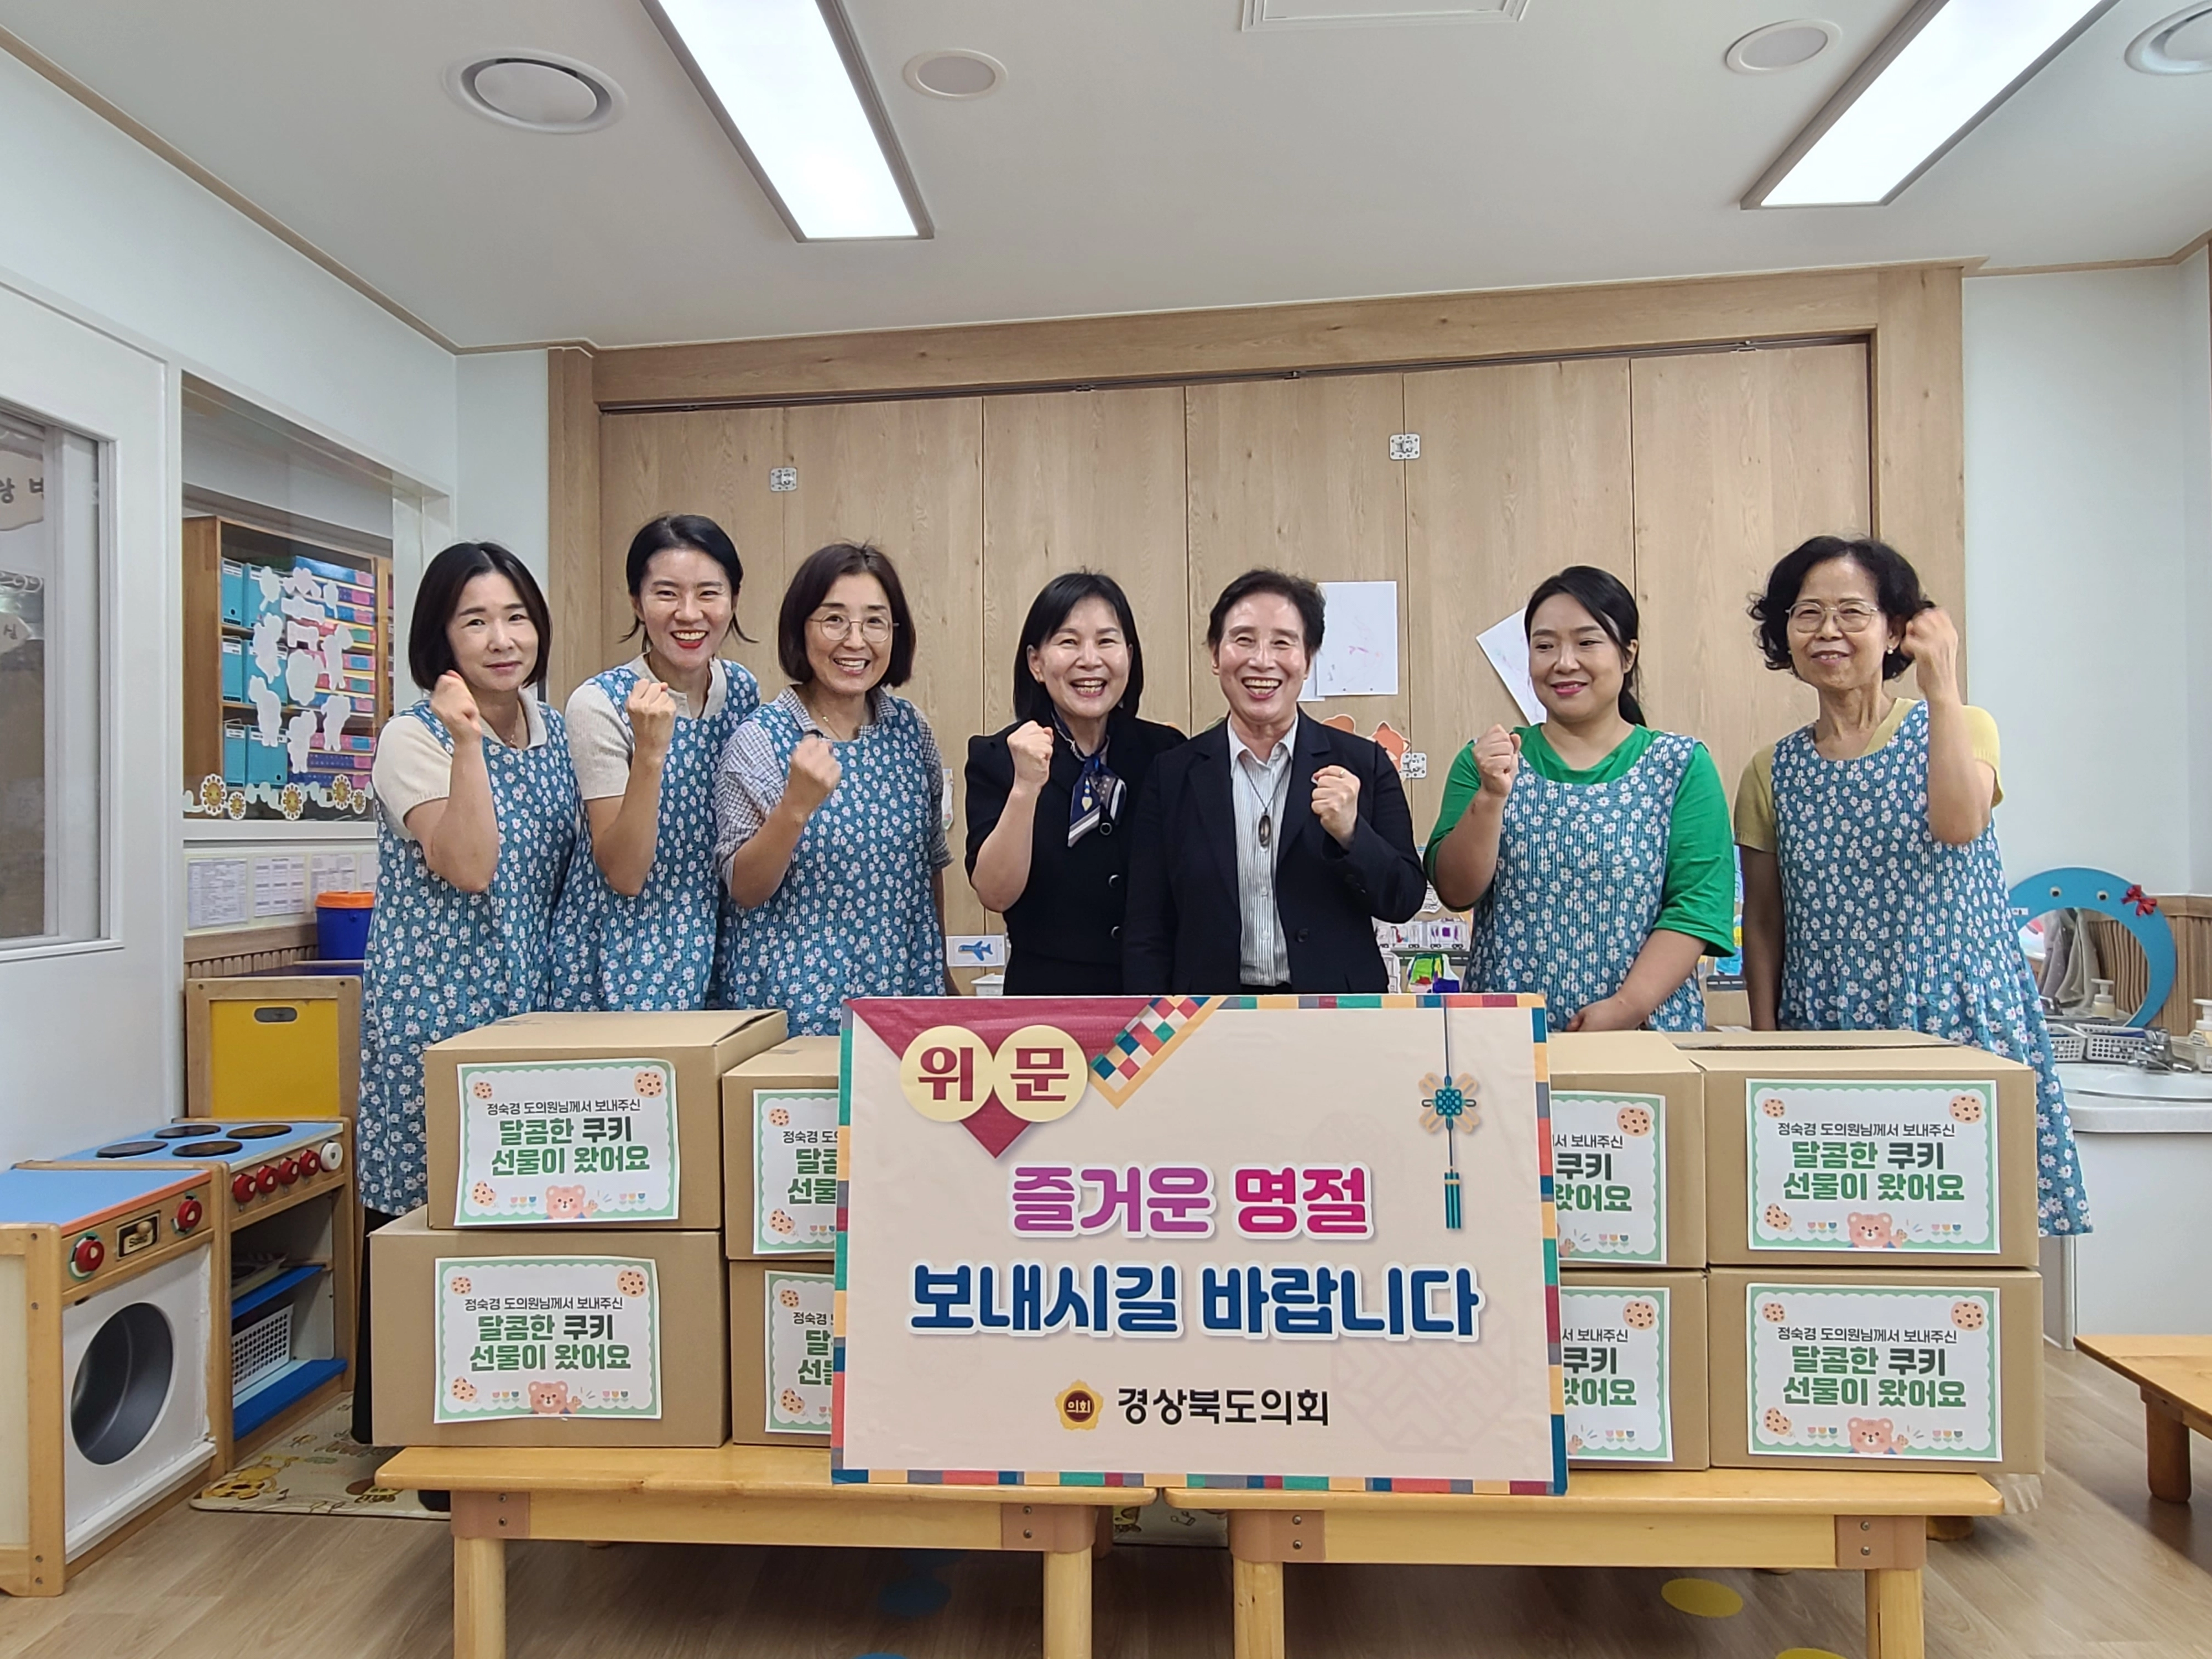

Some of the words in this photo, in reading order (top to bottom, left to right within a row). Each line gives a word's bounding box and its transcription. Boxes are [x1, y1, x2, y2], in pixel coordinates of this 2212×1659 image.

[917, 1047, 1070, 1102] 위문
[487, 1102, 520, 1116] 정숙경
[524, 1100, 592, 1114] 도의원님께서
[595, 1099, 641, 1112] 보내주신
[499, 1118, 574, 1146] 달콤한
[582, 1116, 632, 1143] 쿠키
[782, 1130, 818, 1144] 정숙경
[1571, 1135, 1623, 1149] 보내주신
[1777, 1122, 1817, 1136] 정숙경
[1820, 1123, 1898, 1137] 도의원님께서
[1902, 1124, 1955, 1138] 보내주신
[492, 1147, 565, 1176] 선물이
[574, 1146, 650, 1173] 왔어요
[1556, 1153, 1612, 1181] 쿠키
[1792, 1141, 1878, 1170] 달콤한
[1887, 1142, 1944, 1170] 쿠키
[1012, 1166, 1211, 1233] 즐거운
[1235, 1167, 1368, 1233] 명절
[1783, 1172, 1867, 1201] 선물이
[1877, 1173, 1965, 1202] 왔어요
[465, 1297, 500, 1311] 정숙경
[504, 1297, 574, 1310] 도의원님께서
[577, 1297, 623, 1310] 보내주신
[910, 1264, 1178, 1332] 보내시길
[1202, 1266, 1480, 1336] 바랍니다
[478, 1314, 555, 1341] 달콤한
[563, 1314, 613, 1340] 쿠키
[792, 1312, 827, 1326] 정숙경
[1577, 1328, 1628, 1343] 보내주신
[1777, 1326, 1817, 1341] 정숙경
[1820, 1328, 1900, 1343] 도의원님께서
[1903, 1329, 1958, 1344] 보내주신
[469, 1344, 546, 1372] 선물이
[555, 1344, 632, 1370] 왔어요
[1563, 1347, 1617, 1375] 쿠키
[1792, 1345, 1879, 1375] 달콤한
[1888, 1348, 1946, 1376] 쿠키
[1066, 1400, 1091, 1413] 의회
[1118, 1387, 1329, 1426] 경상북도의회
[1782, 1377, 1869, 1405] 선물이
[1878, 1379, 1967, 1408] 왔어요
